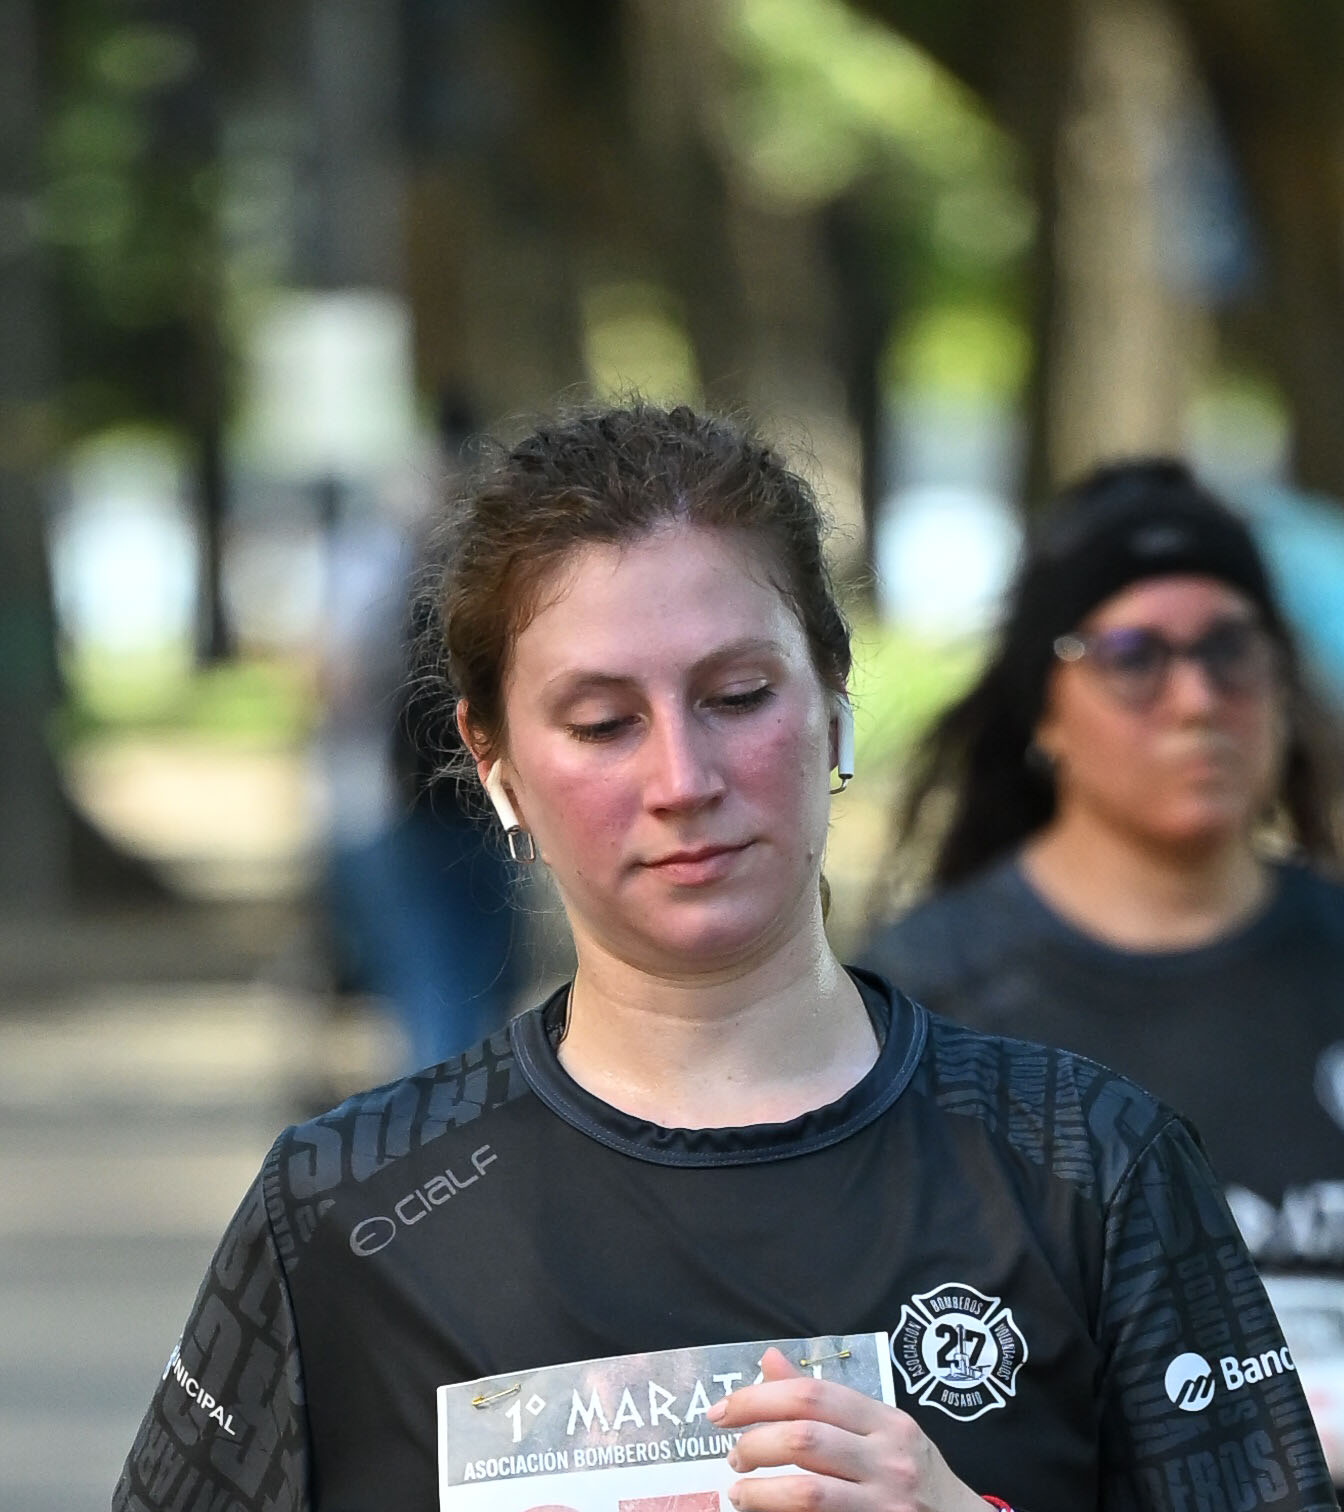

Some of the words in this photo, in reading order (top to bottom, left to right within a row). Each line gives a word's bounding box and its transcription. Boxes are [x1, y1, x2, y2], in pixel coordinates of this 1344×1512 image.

[929, 1296, 984, 1315] BOMBEROS
[935, 1323, 987, 1369] 27
[171, 1352, 236, 1435] NICIPAL
[940, 1389, 984, 1408] ROSARIO
[464, 1447, 570, 1481] ASOCIACIÓN
[574, 1439, 672, 1468] BOMBEROS
[675, 1432, 743, 1457] VOLUNT
